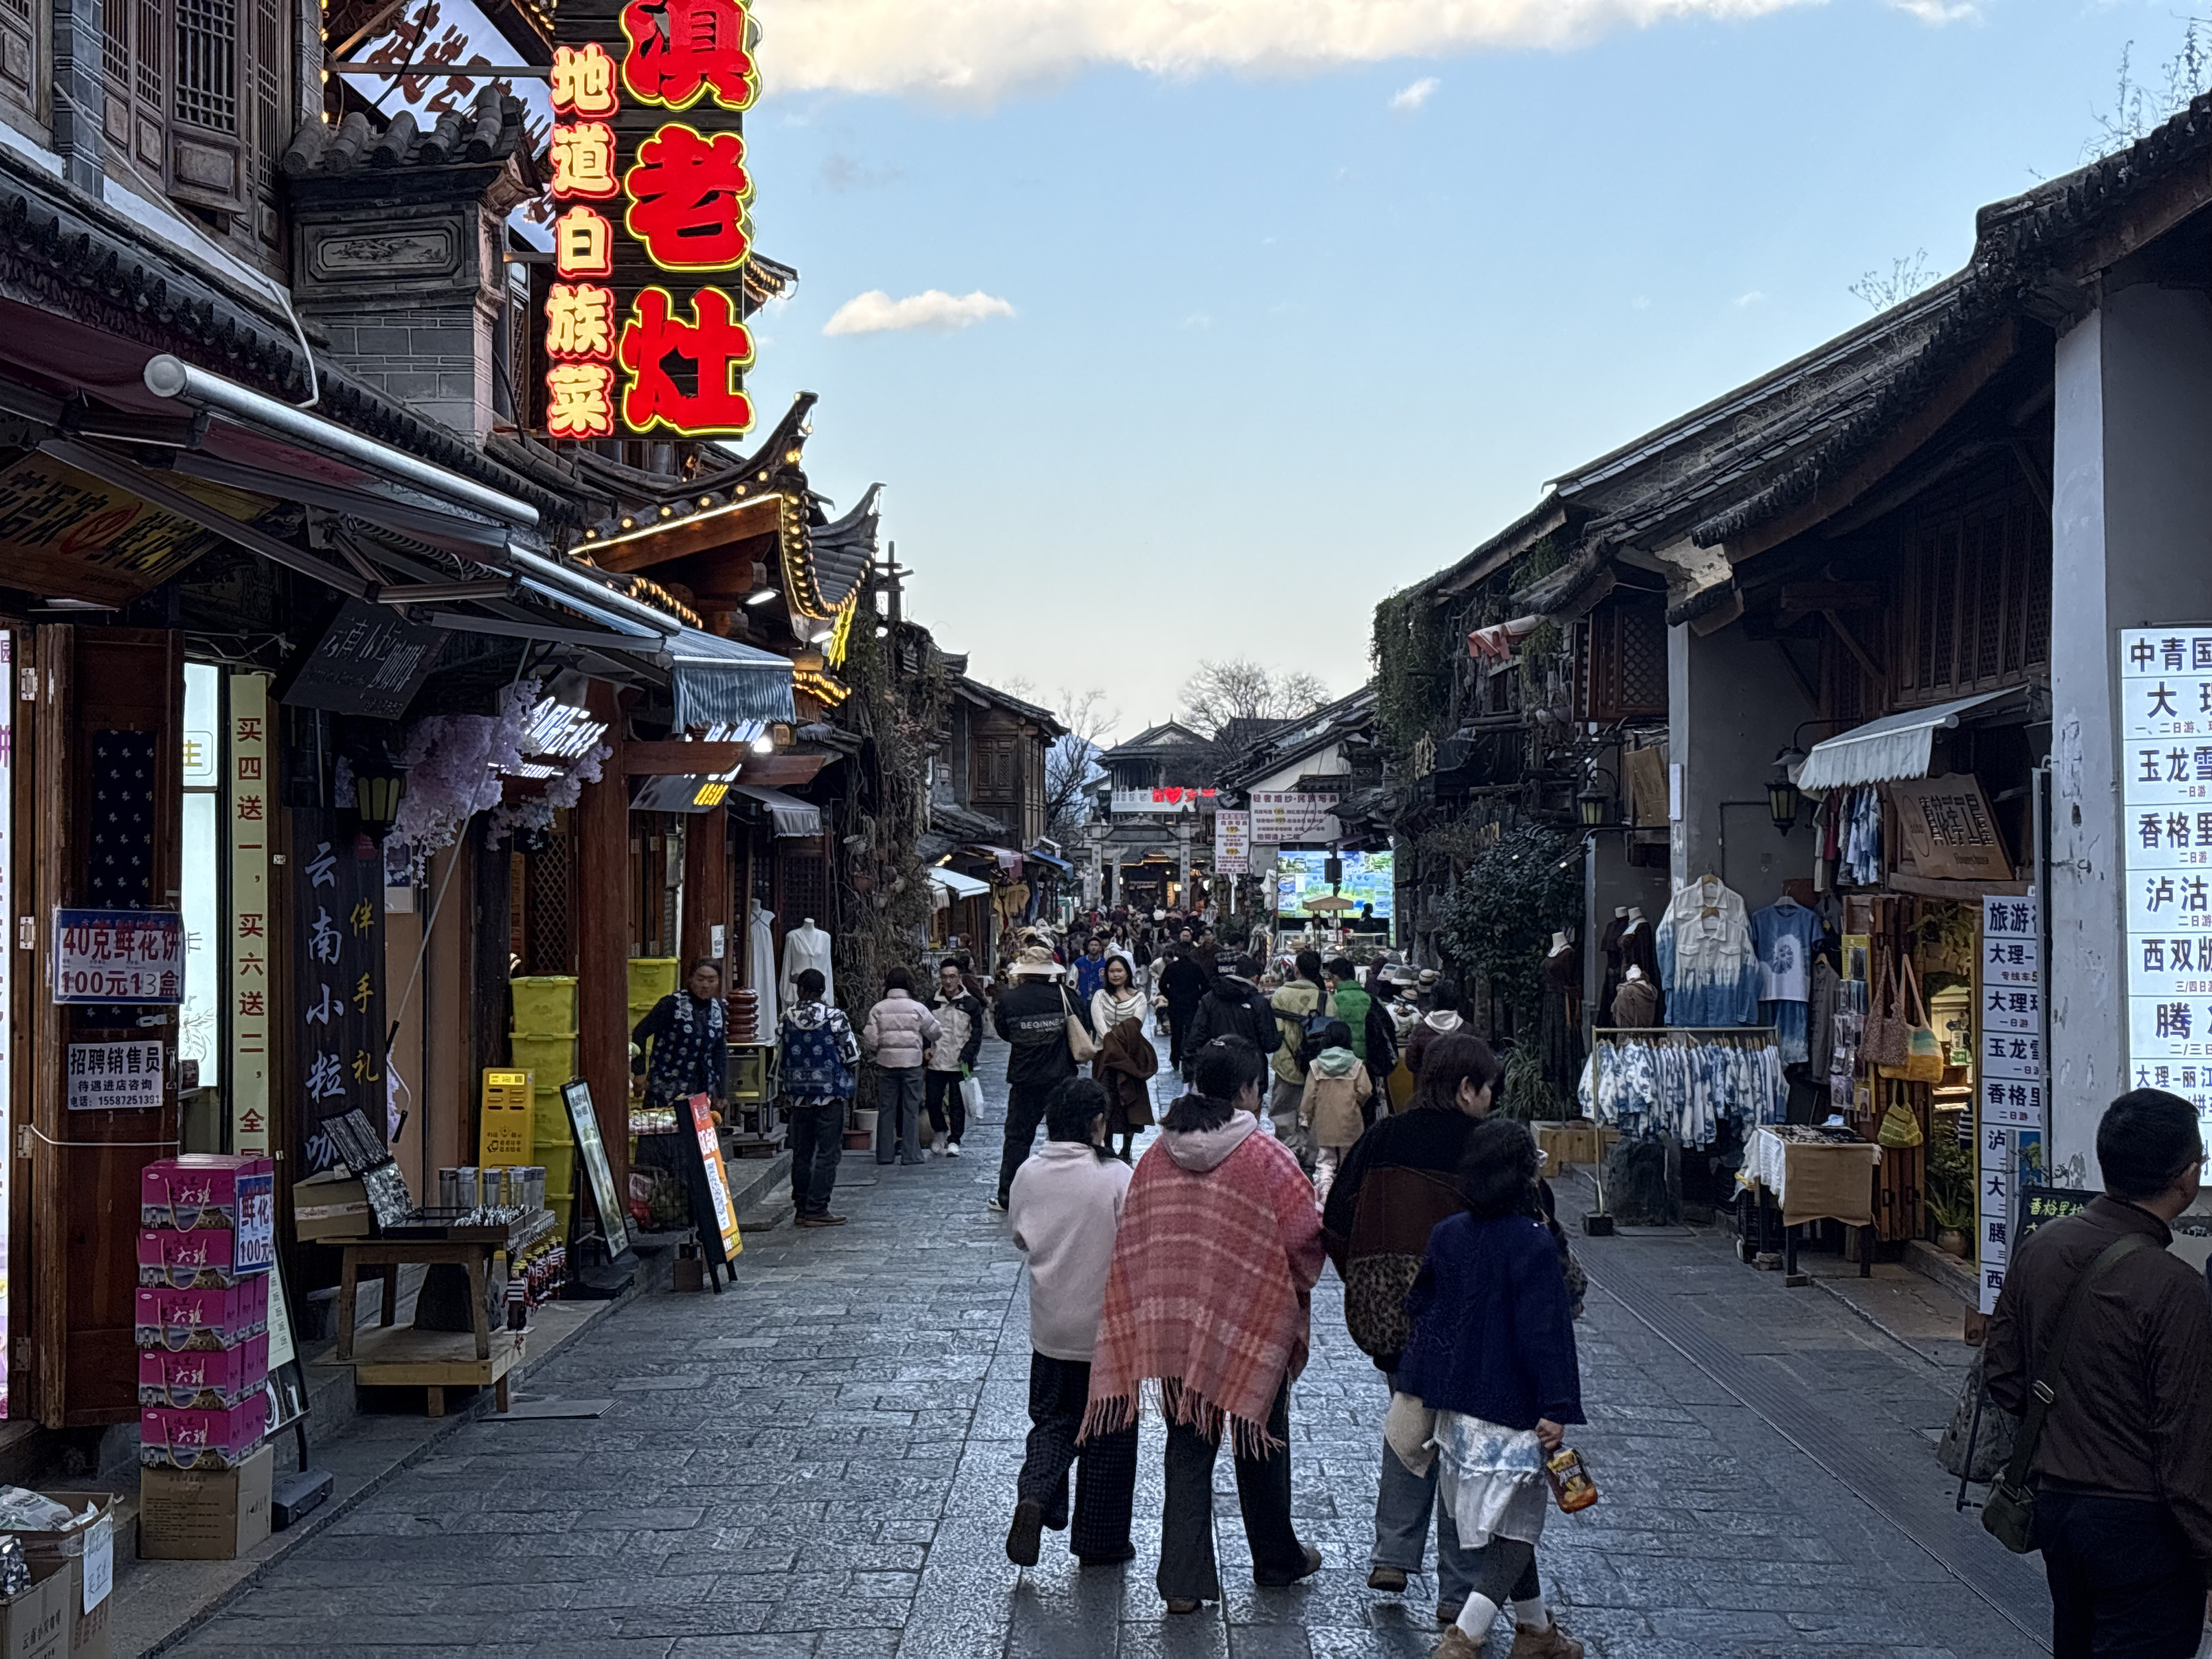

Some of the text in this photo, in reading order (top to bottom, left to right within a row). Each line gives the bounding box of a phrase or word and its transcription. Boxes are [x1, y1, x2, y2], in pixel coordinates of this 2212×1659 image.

[619, 0, 755, 436] 滇老灶
[547, 43, 618, 439] 地道白族菜
[2146, 875, 2209, 912] 泸沽
[1989, 902, 2037, 933] 旅游
[63, 920, 180, 962] 40克鲜花饼
[237, 717, 265, 1157] 买四送一，买六送二，全
[1989, 943, 2037, 964] 大理-
[350, 897, 379, 1084] 伴手礼
[2156, 1002, 2212, 1040] 腾
[70, 1046, 160, 1076] 招聘销售员
[78, 1079, 153, 1092] 待遇进店咨询
[1987, 1176, 2005, 1198] 大
[241, 1186, 272, 1228] 鲜花
[240, 1236, 273, 1264] 100元
